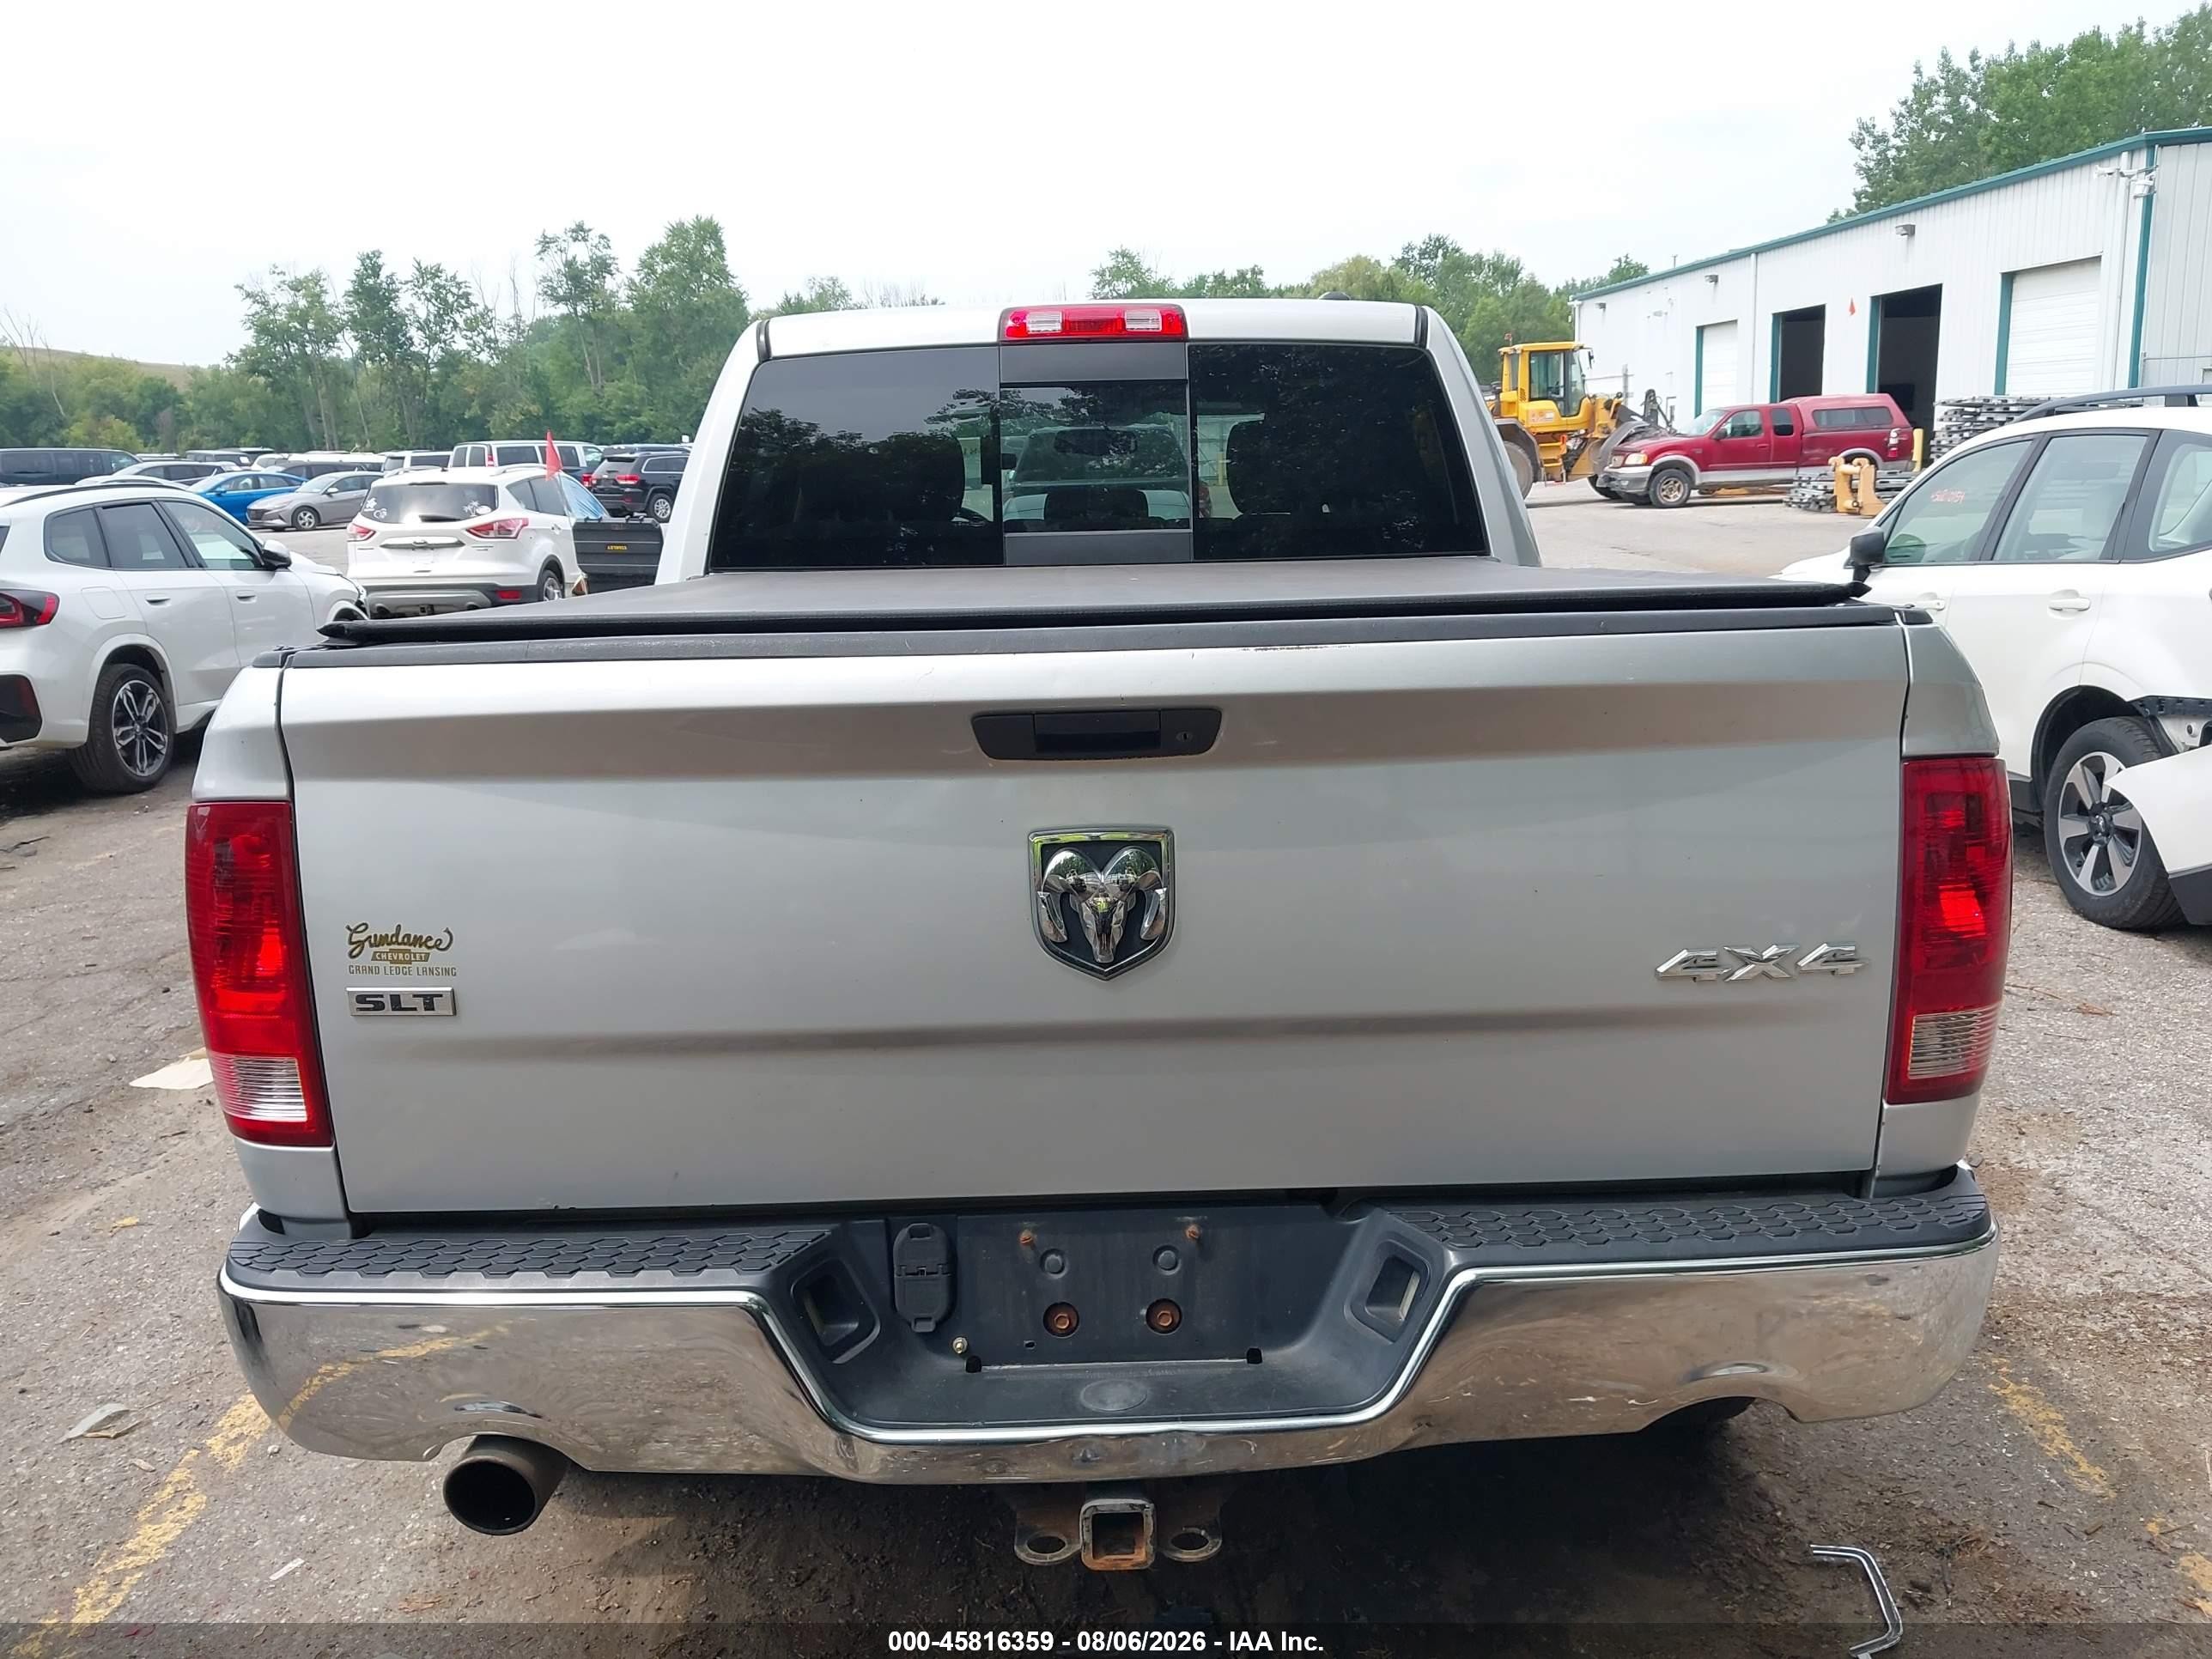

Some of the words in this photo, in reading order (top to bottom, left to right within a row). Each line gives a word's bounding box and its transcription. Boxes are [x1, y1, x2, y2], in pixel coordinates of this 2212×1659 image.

[375, 951, 426, 961] CHEVROLET
[349, 965, 380, 975] GRAND
[384, 966, 413, 975] LEDGE
[416, 967, 457, 976] LANSING
[356, 994, 443, 1012] SLT
